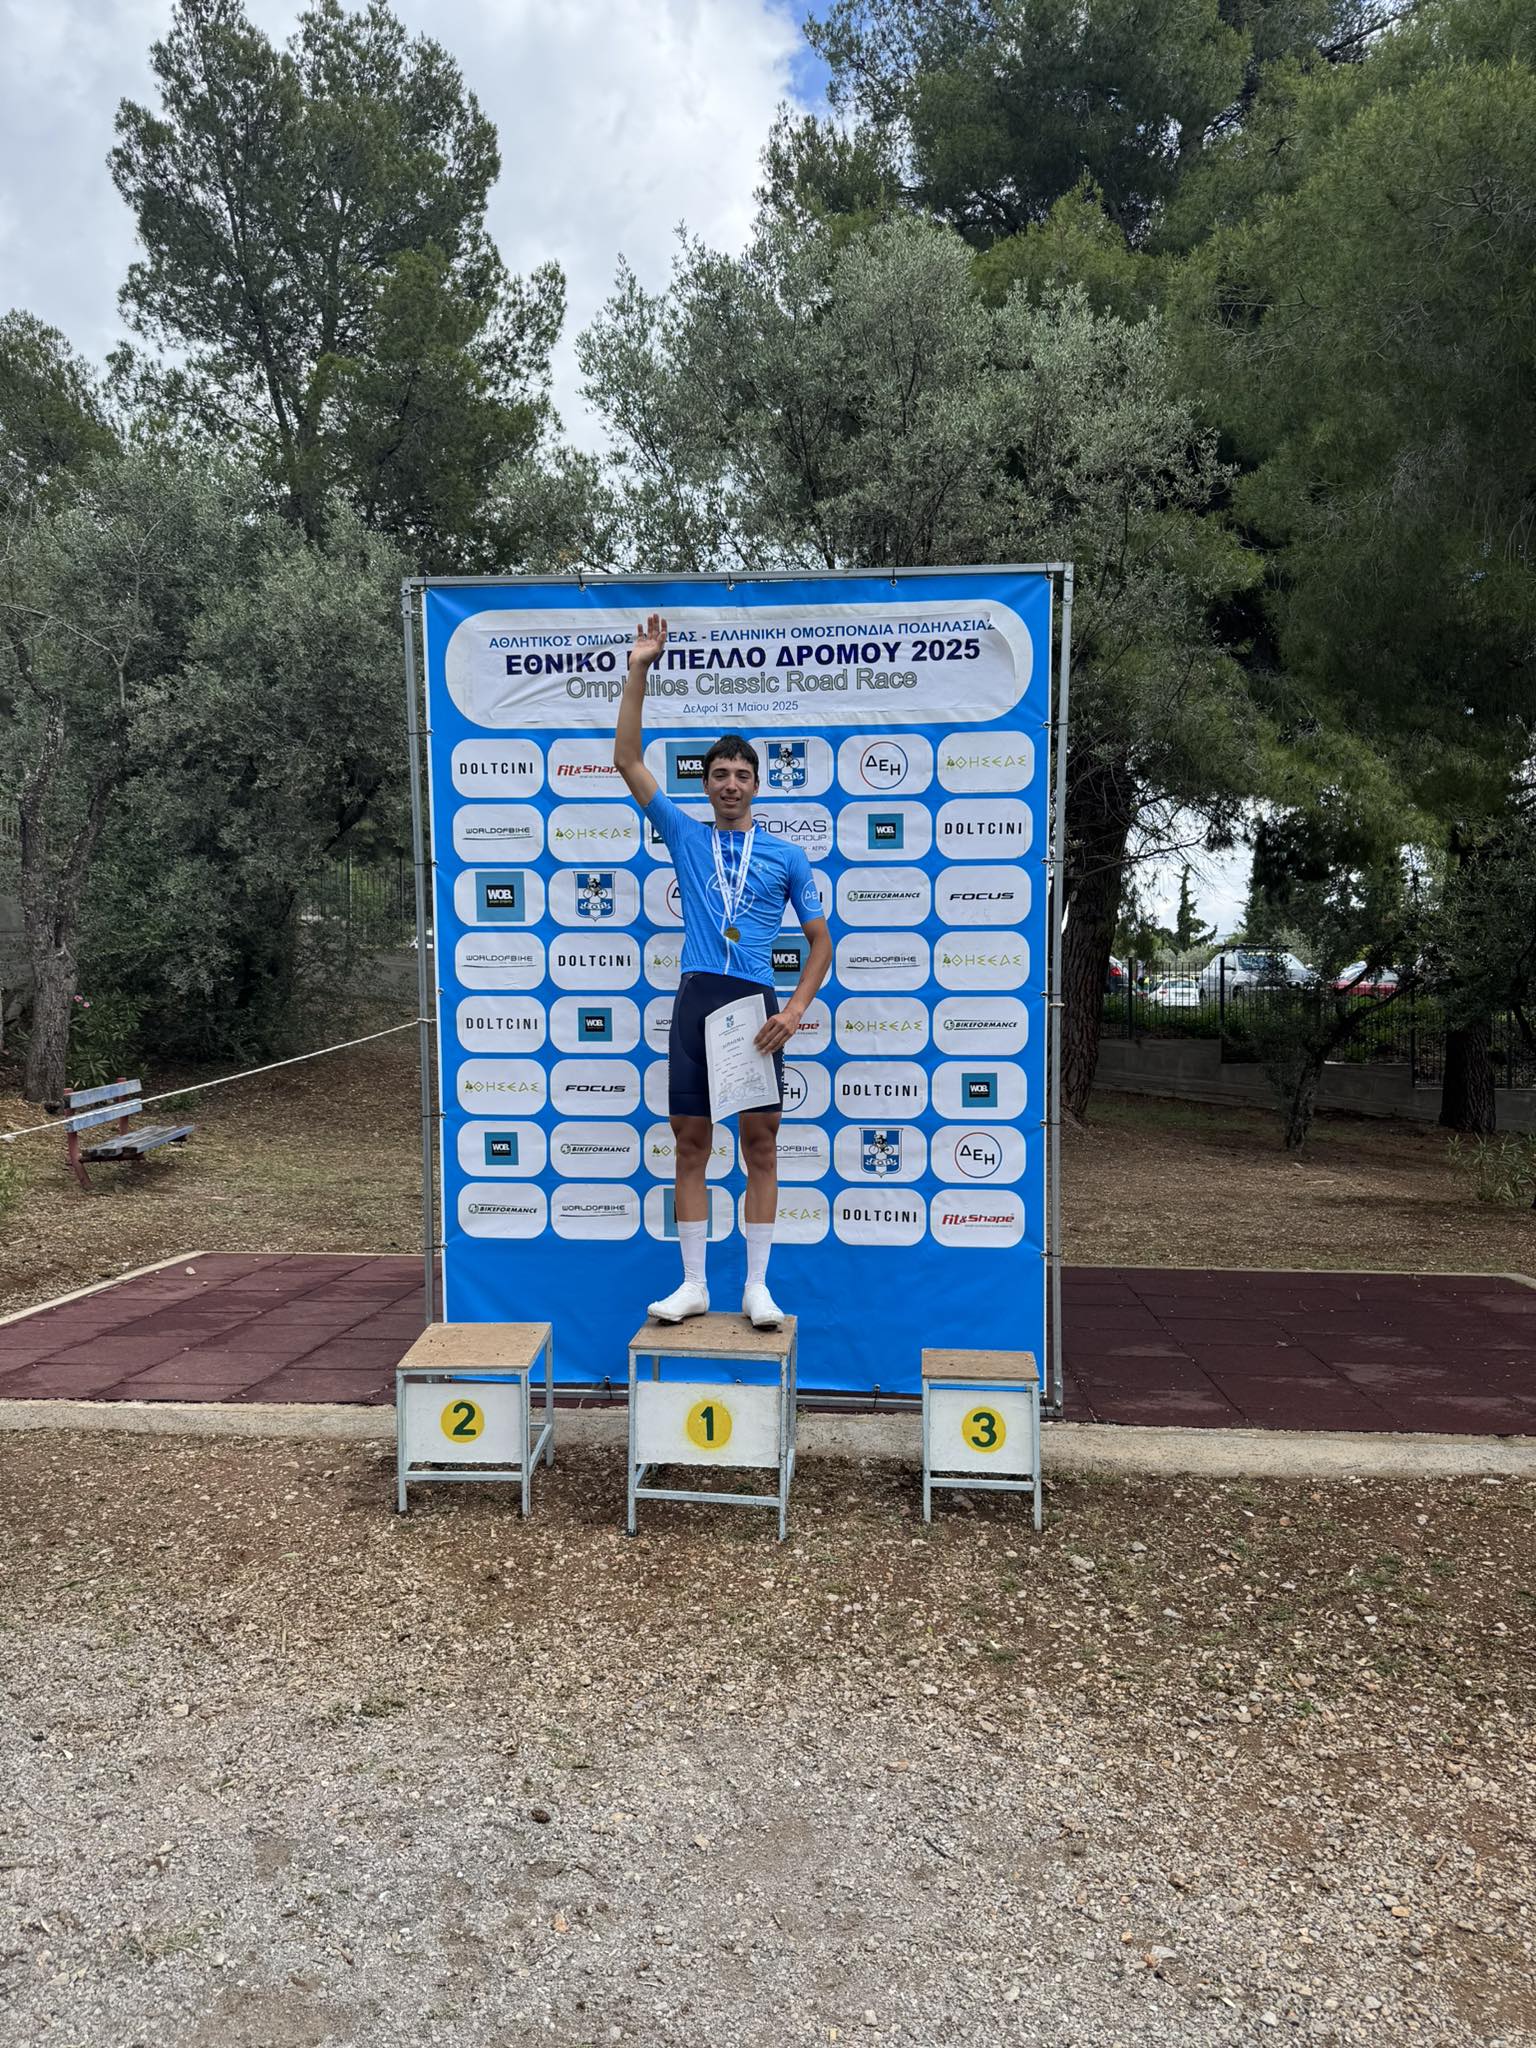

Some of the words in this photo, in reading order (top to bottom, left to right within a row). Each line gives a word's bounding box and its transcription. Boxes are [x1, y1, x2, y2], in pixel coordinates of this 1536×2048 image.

[489, 635, 572, 649] ΑΘΛΗΤΙΚΟΣ
[577, 633, 633, 647] ΟΜΙΛΟΣ
[711, 628, 786, 642] ΕΛΛΗΝΙΚΗ
[791, 623, 894, 640] ΟΜΟΣΠΟΝΔΙΑ
[506, 651, 616, 676] ΕΘΝΙΚΟ
[775, 641, 902, 667] ΔΡΟΜΟΥ
[911, 638, 981, 662] 2025
[566, 675, 689, 702] Omplios
[695, 671, 780, 696] Classic
[786, 669, 848, 693] Road
[856, 668, 918, 691] Race
[683, 703, 719, 716] Δελφοί
[721, 703, 734, 713] 31
[772, 701, 799, 712] 2025
[460, 762, 534, 775] DOLTCINI
[557, 764, 618, 776] Fit&Shap
[865, 755, 901, 776] ΔΕΗ
[944, 822, 1023, 835] DOLTCINI
[791, 834, 827, 842] GROUP
[859, 892, 921, 900] BIKEFORMANCE
[949, 892, 1015, 901] FOCUS
[466, 954, 534, 962] WORLDOFBIKE
[558, 955, 632, 967] DOLTCINI
[466, 1017, 539, 1030] DOLTCINI
[565, 1085, 626, 1093] FOCUS
[783, 1083, 801, 1099] ΕΗ
[842, 1084, 918, 1097] DOLTCINI
[960, 1145, 995, 1165] ΔΕΗ
[479, 1206, 538, 1214] BIKEFORMANCE
[842, 1208, 918, 1223] DOLTCINI
[942, 1213, 1015, 1225] Fit&Shape
[451, 1402, 477, 1437] 2
[700, 1405, 715, 1442] 1
[971, 1411, 998, 1448] 3
